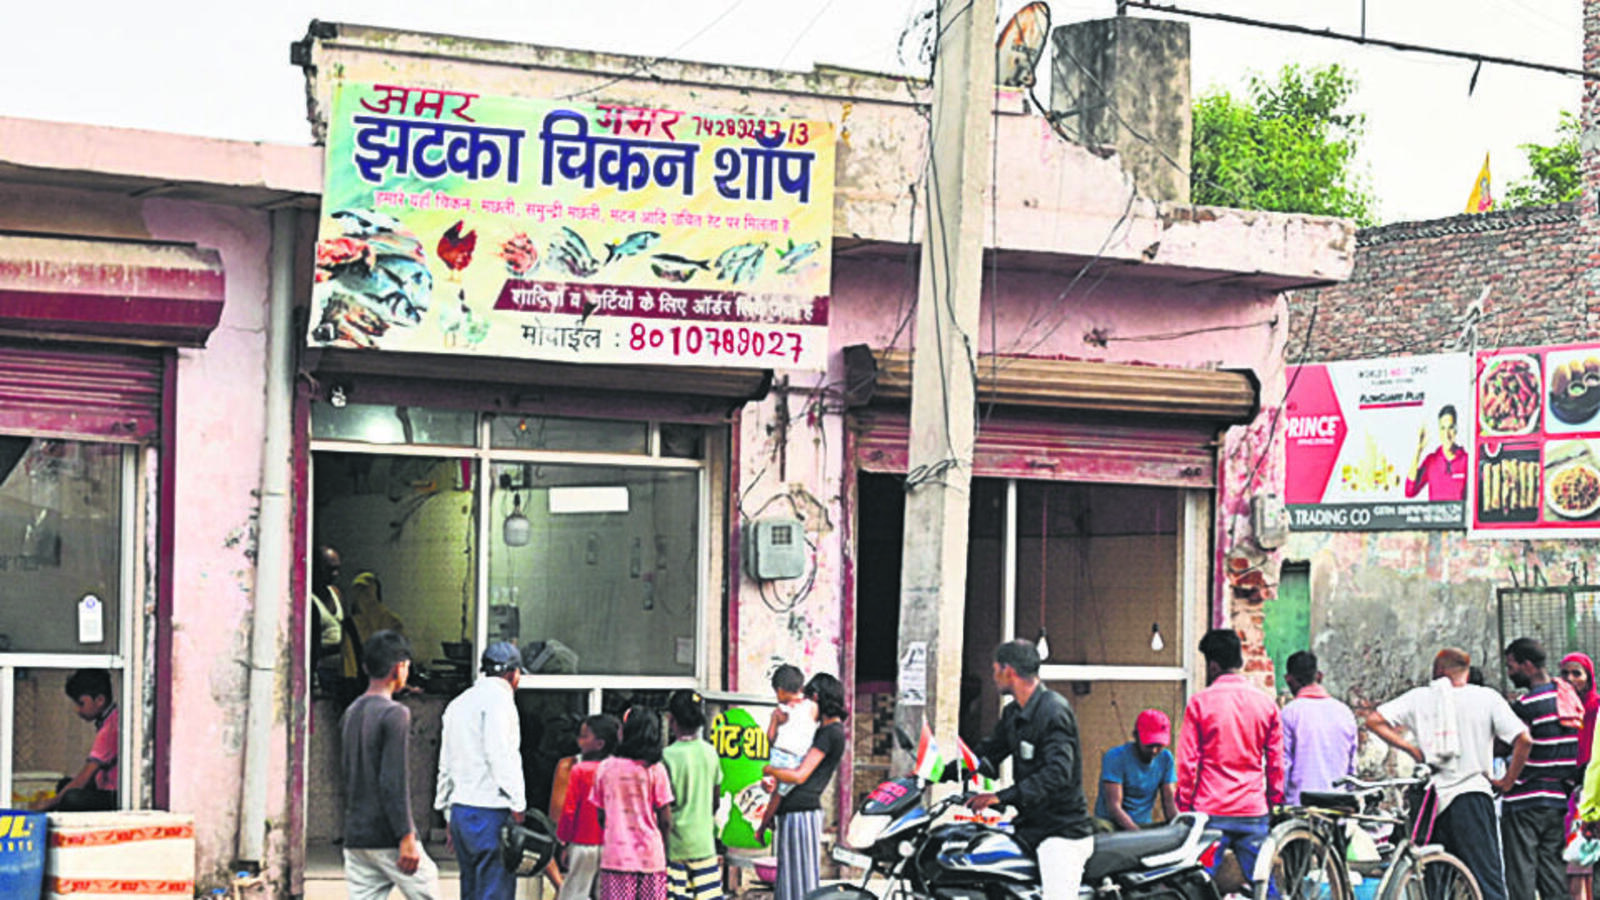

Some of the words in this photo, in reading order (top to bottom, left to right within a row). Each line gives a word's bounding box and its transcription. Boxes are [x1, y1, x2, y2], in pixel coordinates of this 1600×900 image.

[360, 84, 480, 122] अमर
[354, 116, 525, 183] झटका
[539, 109, 699, 195] चिकन
[714, 130, 815, 203] शॉप
[638, 291, 655, 311] के
[659, 291, 687, 316] लिए
[630, 323, 803, 363] 8010789027
[1295, 509, 1348, 526] TRADING
[1350, 508, 1371, 525] CO
